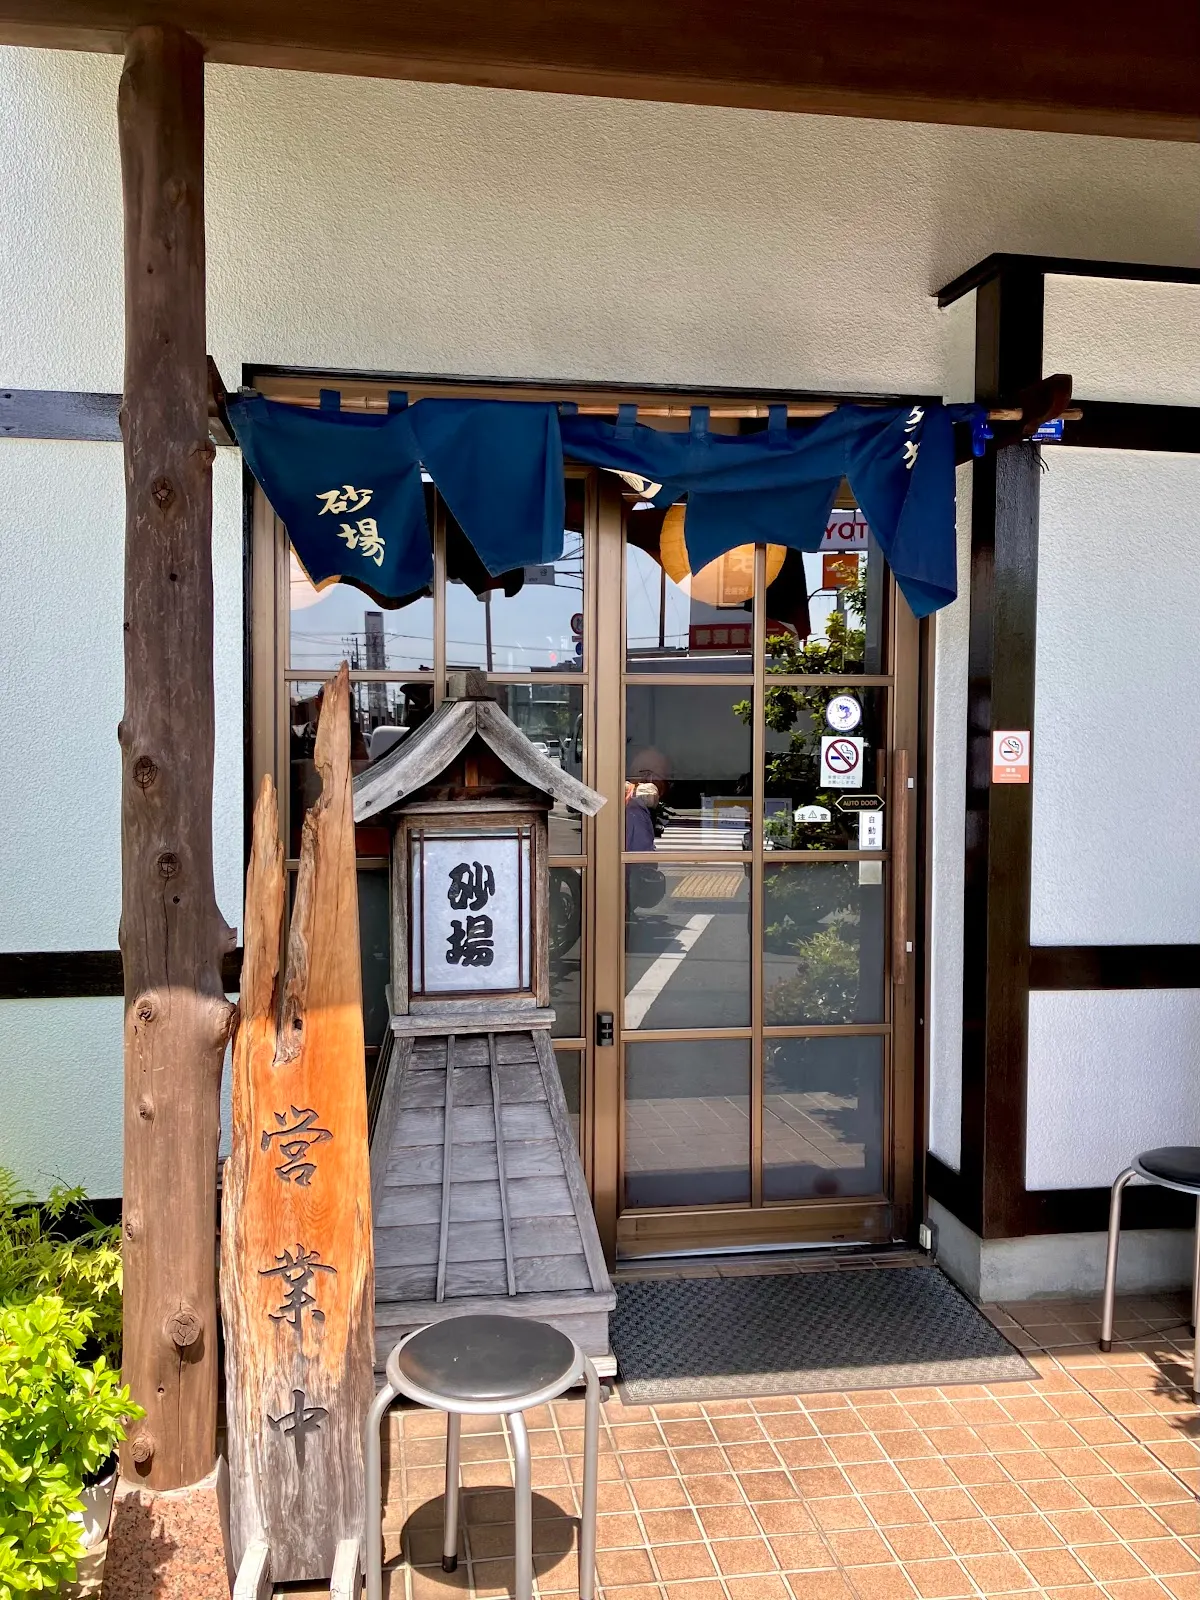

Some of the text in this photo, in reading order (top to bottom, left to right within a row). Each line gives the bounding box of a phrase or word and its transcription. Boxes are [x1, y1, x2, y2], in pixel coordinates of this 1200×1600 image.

[315, 484, 387, 567] 砂場
[445, 860, 496, 968] 砂場
[257, 1104, 338, 1469] 営業中
